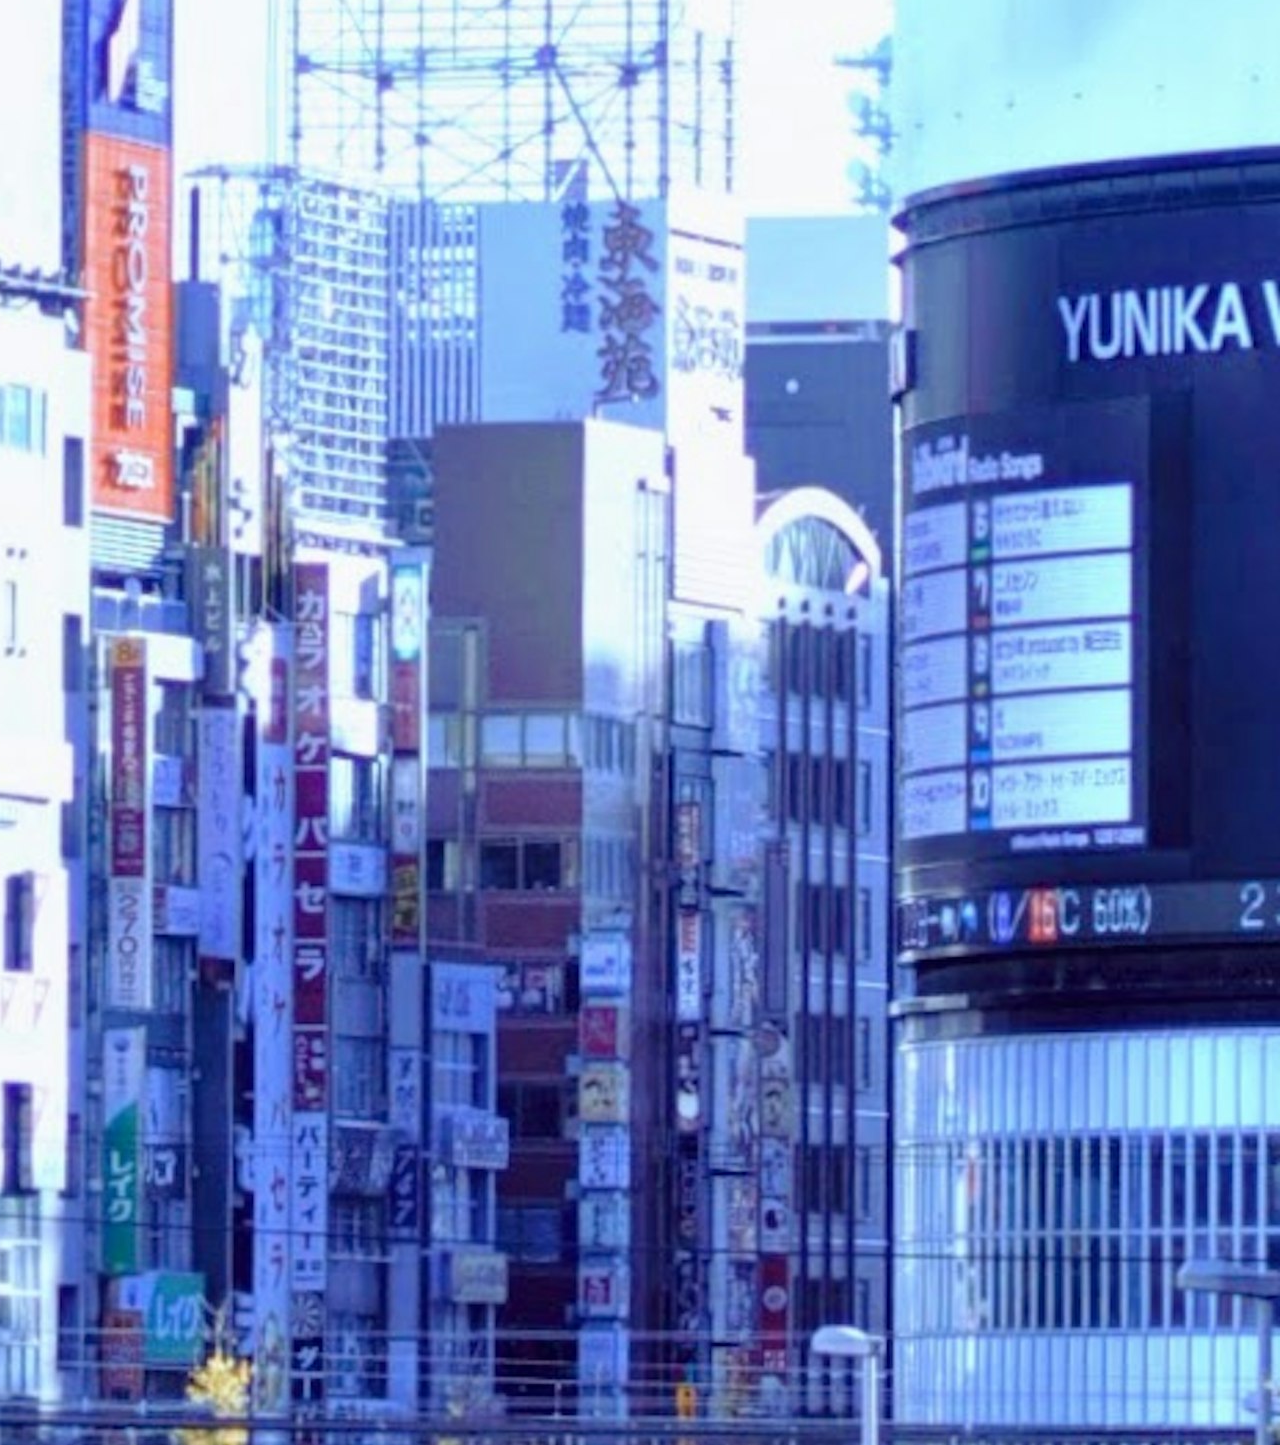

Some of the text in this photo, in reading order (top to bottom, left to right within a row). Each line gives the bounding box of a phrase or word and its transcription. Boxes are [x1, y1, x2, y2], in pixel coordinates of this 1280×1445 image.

[1058, 283, 1252, 362] YUNIKA
[109, 1150, 134, 1223] レイク
